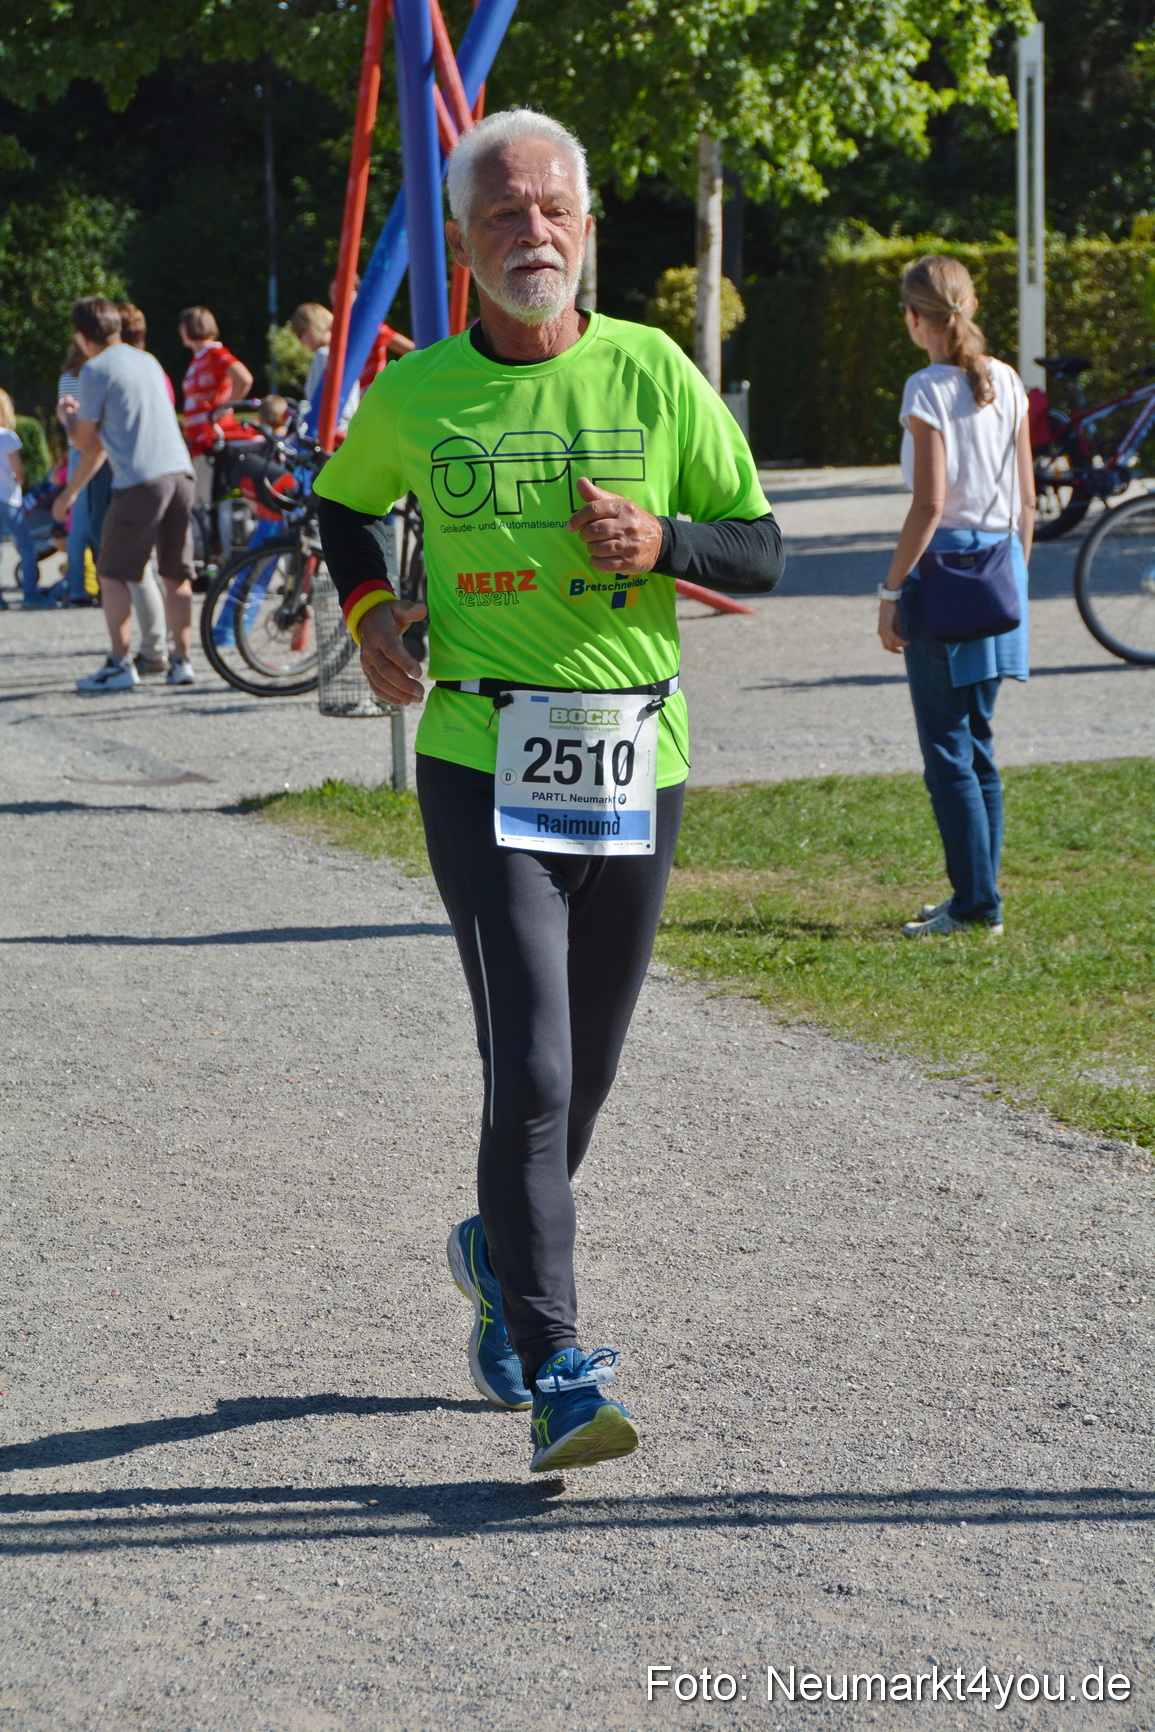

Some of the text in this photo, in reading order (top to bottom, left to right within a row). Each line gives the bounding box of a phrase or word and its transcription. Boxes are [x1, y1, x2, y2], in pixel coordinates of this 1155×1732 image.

[440, 523, 475, 533] Gebäude-
[479, 520, 496, 531] und
[457, 569, 538, 595] MERZ
[569, 577, 649, 596] Bretschneider
[550, 707, 620, 725] BOCK
[522, 737, 635, 786] 2510
[505, 772, 512, 781] D
[532, 792, 615, 804] PARTL Neumarkt
[537, 813, 620, 836] Raimund
